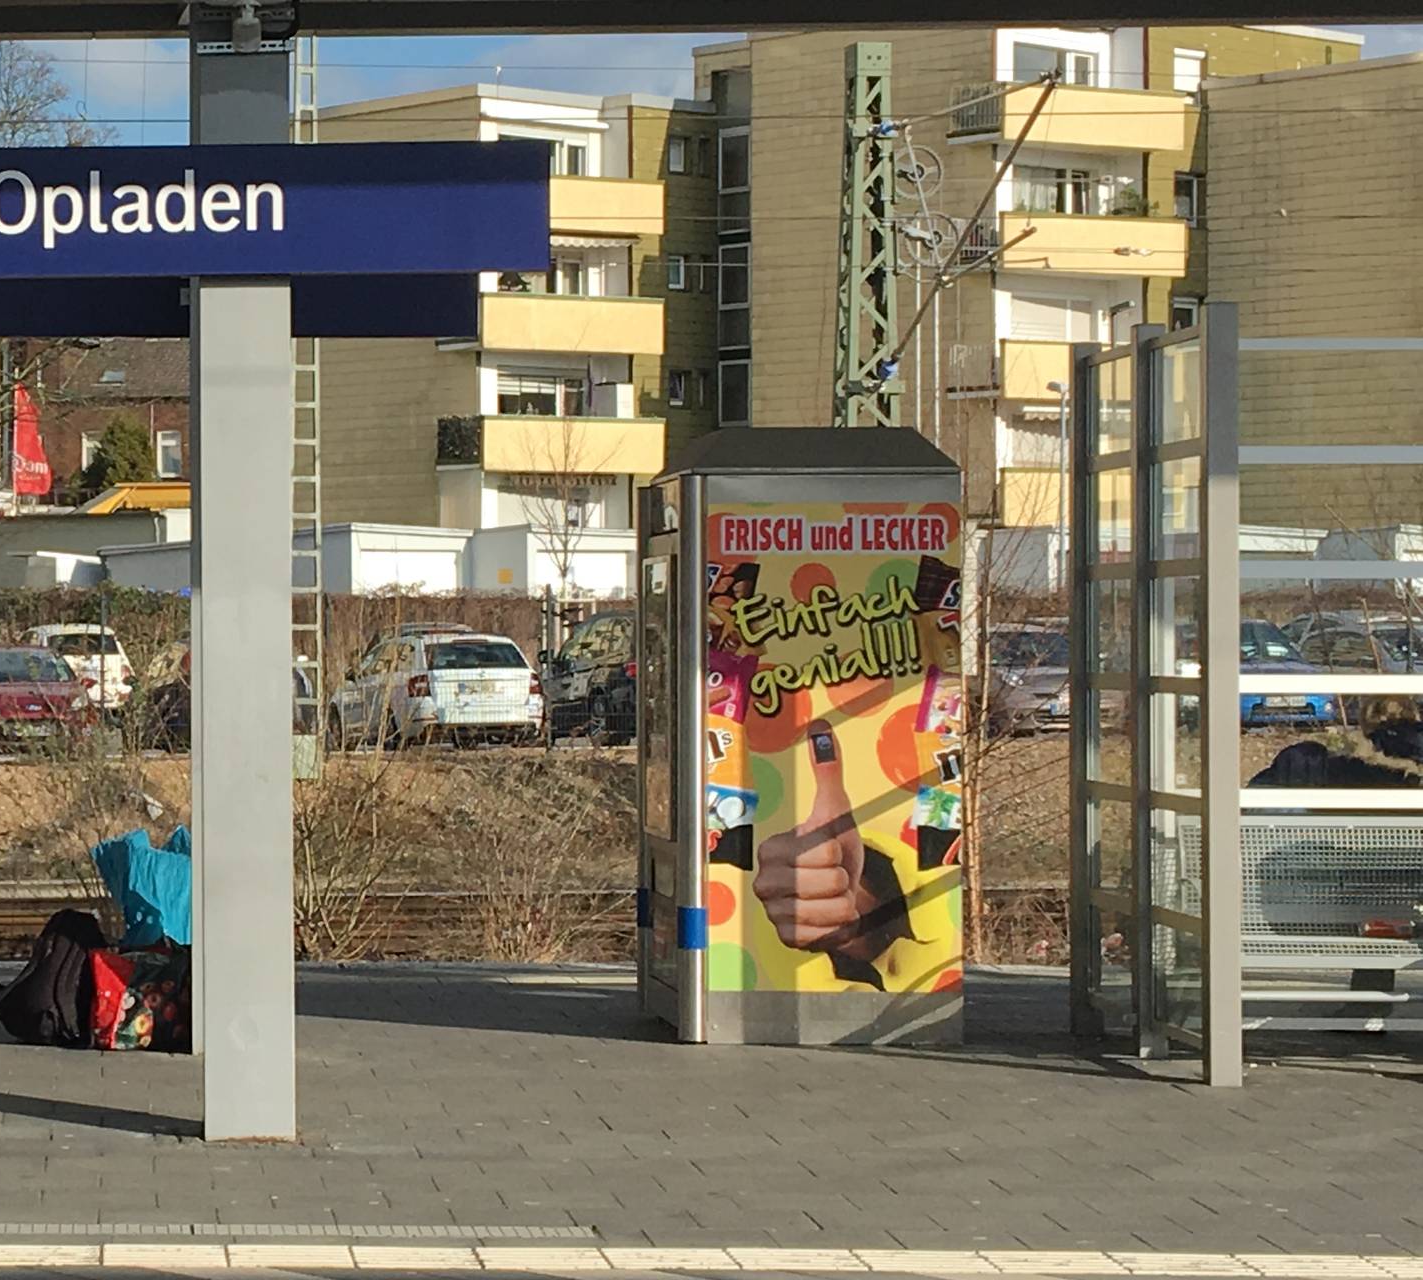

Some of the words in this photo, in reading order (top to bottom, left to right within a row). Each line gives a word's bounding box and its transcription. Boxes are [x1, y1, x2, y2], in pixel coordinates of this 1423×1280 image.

[724, 518, 803, 551] FRISCH
[810, 517, 853, 551] und
[860, 518, 946, 551] LECKER
[730, 575, 922, 646] Einfach
[750, 619, 923, 717] genial!!!
